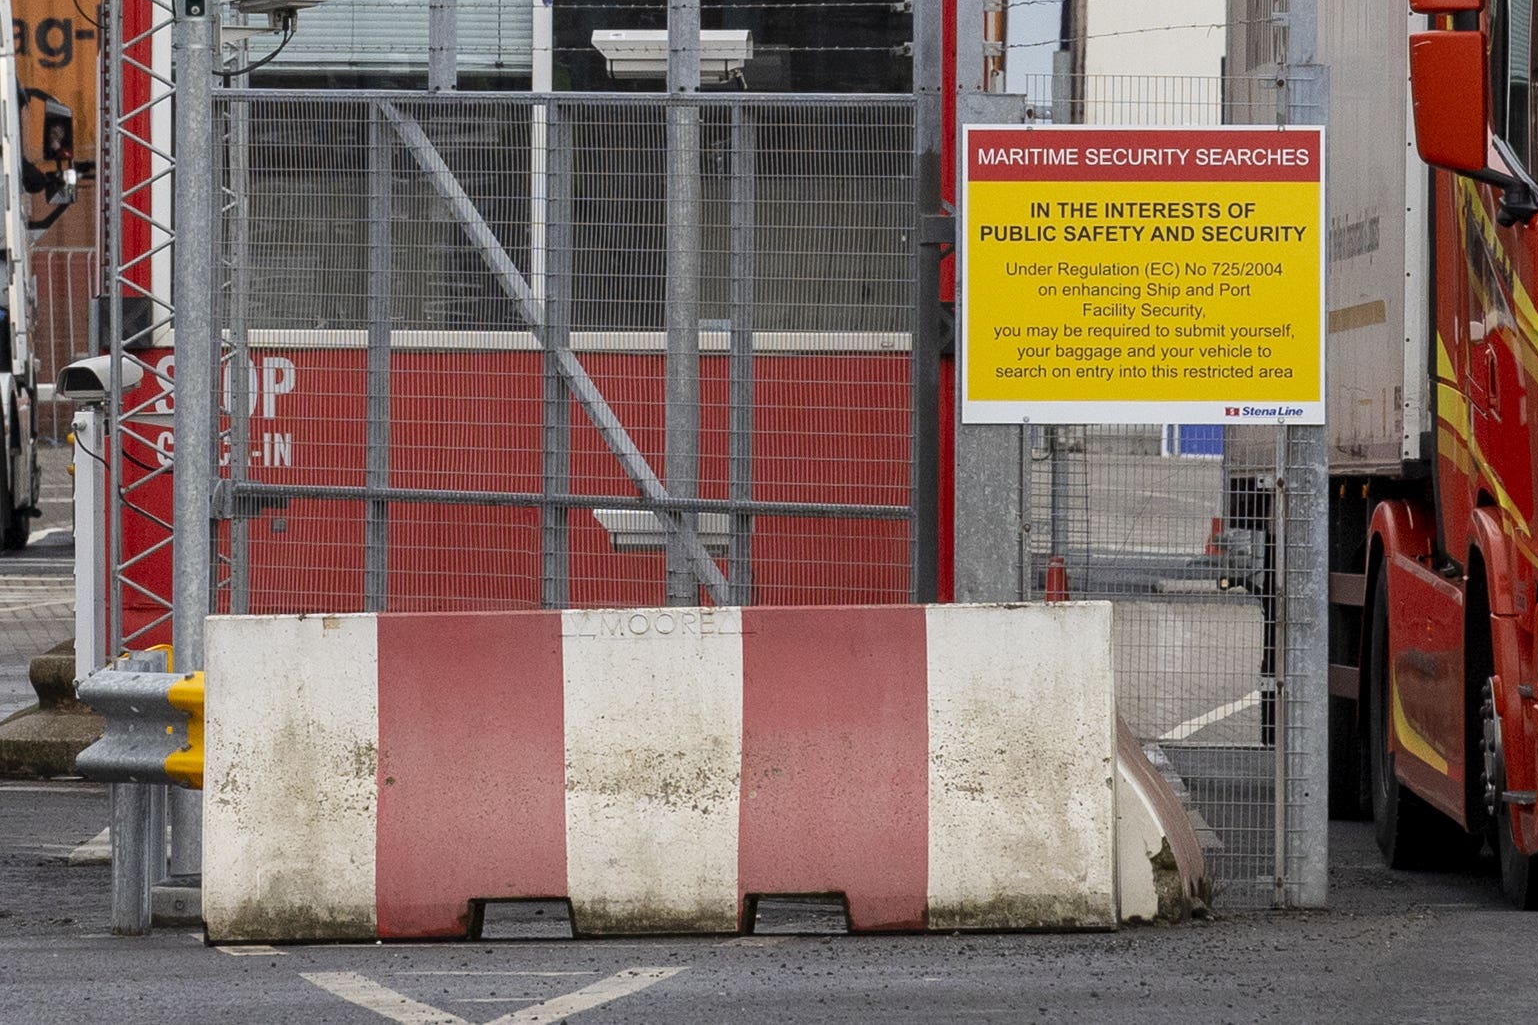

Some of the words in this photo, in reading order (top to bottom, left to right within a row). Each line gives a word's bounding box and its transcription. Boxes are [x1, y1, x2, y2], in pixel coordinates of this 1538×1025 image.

[978, 148, 1079, 166] MARITIME
[1085, 148, 1190, 166] SECURITY
[1195, 148, 1310, 166] SEARCHES
[1031, 202, 1050, 219] IN
[1056, 202, 1098, 219] THE
[1105, 202, 1221, 219] INTERESTS
[1227, 202, 1256, 219] OF
[980, 225, 1057, 242] PUBLIC
[1063, 225, 1145, 242] SAFETY
[1150, 225, 1195, 242] AND
[1201, 225, 1307, 242] SECURITY
[1006, 262, 1053, 276] Under
[1057, 261, 1140, 280] Regulation
[1144, 261, 1180, 279] (EC)
[1184, 262, 1207, 277] No
[1212, 262, 1283, 277] 725/2004
[1038, 285, 1057, 297] on
[1062, 282, 1142, 300] enhancing
[1146, 282, 1181, 300] Ship
[1185, 282, 1214, 297] and
[1219, 282, 1251, 297] Port
[1082, 302, 1136, 320] Facility
[1141, 302, 1206, 321] Security,
[993, 326, 1021, 341] you
[1026, 326, 1059, 341] may
[1063, 323, 1083, 338] be
[1087, 323, 1150, 340] required
[1155, 324, 1170, 338] to
[1174, 323, 1226, 338] submit
[1230, 323, 1295, 341] yourself,
[1017, 346, 1051, 361] your
[1055, 344, 1122, 361] baggage
[1126, 344, 1156, 358] and
[1160, 347, 1195, 362] your
[1198, 344, 1253, 358] vehicle
[1257, 345, 1272, 358] to
[995, 364, 1047, 378] search
[1051, 367, 1071, 378] on
[1075, 365, 1114, 382] entry
[1119, 364, 1147, 379] into
[1151, 364, 1179, 379] this
[1183, 364, 1254, 379] restricted
[1258, 367, 1293, 379] area
[155, 355, 297, 420] SOP
[1241, 405, 1277, 417] Stena
[1277, 405, 1304, 417] Line
